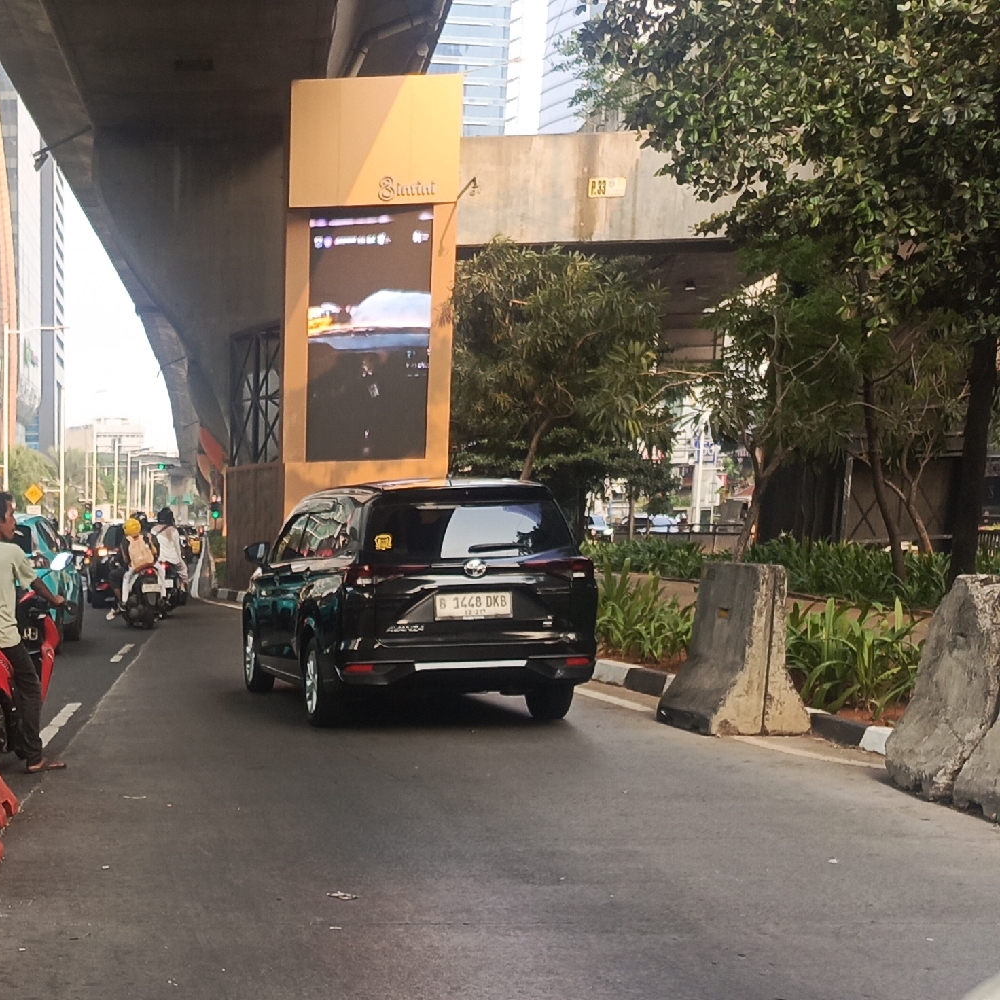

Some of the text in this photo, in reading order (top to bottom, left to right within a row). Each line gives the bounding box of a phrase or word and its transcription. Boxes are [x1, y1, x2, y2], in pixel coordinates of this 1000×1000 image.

[590, 180, 606, 195] P.33
[454, 596, 482, 609] 1448
[485, 595, 508, 608] DKB
